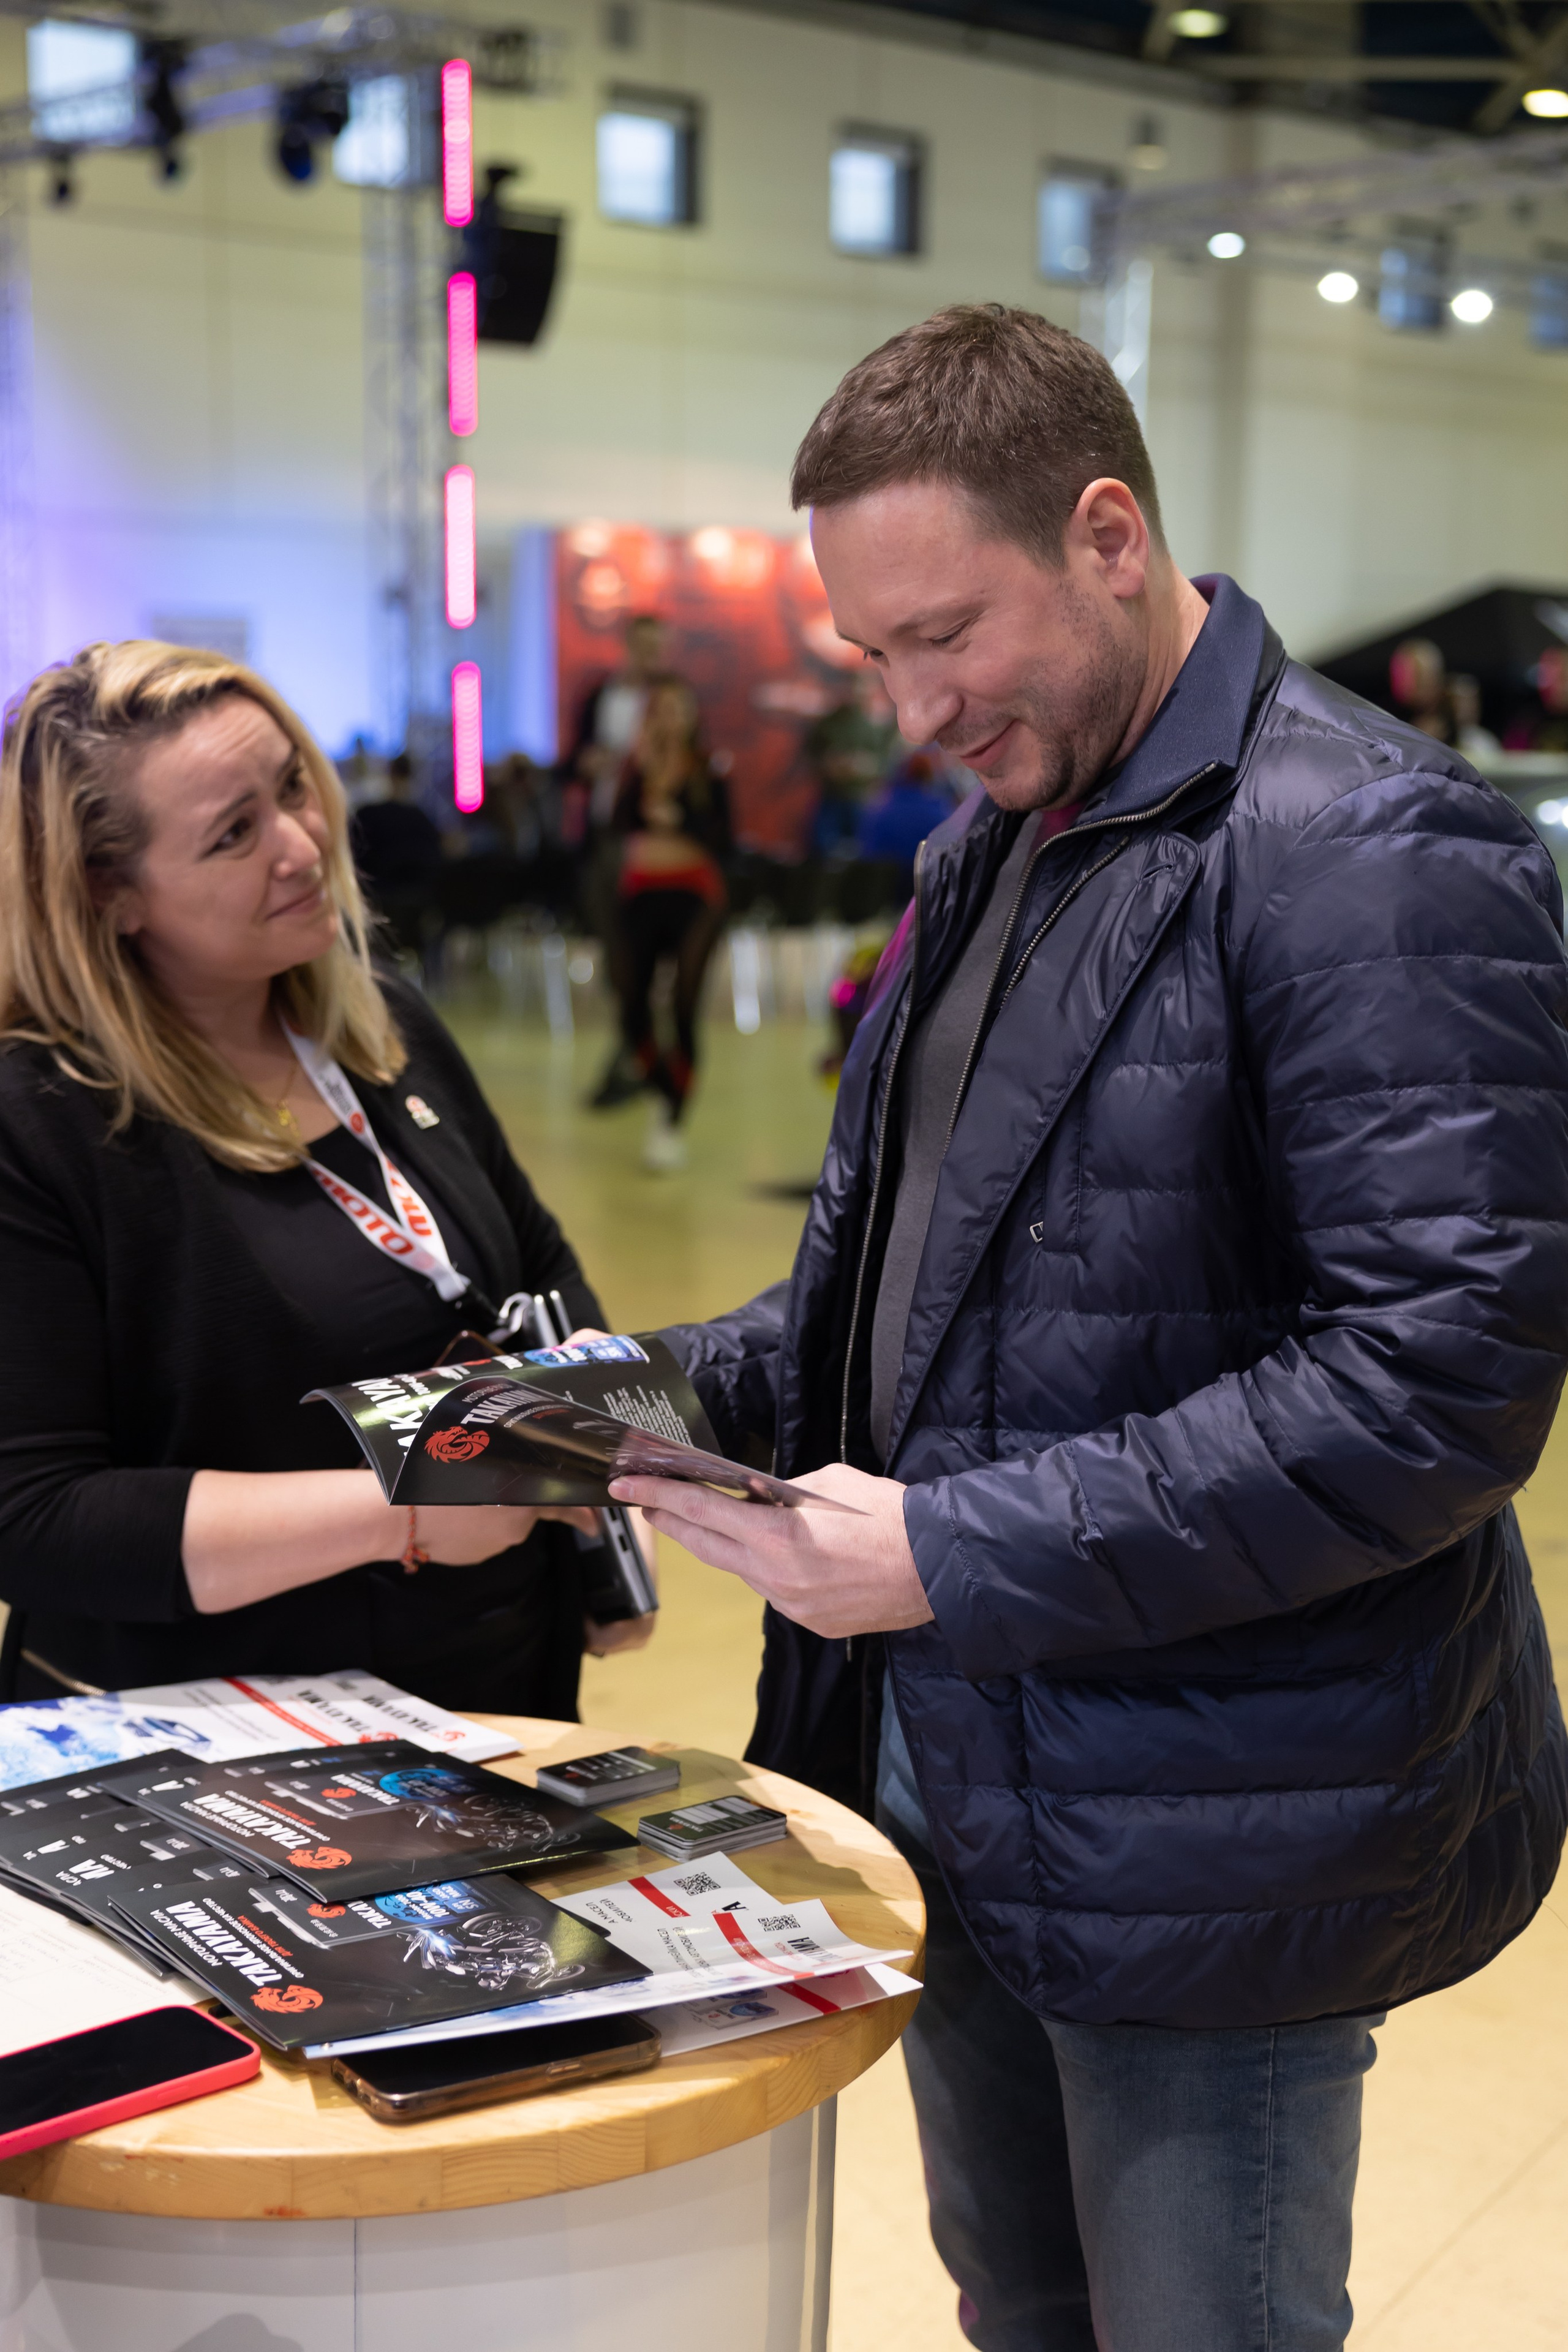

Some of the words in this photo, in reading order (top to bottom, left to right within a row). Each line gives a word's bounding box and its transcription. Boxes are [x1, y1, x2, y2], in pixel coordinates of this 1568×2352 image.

[193, 1793, 311, 1849] TAKAYAMA
[406, 1891, 450, 1918] 10W-40
[459, 1898, 479, 1910] SN
[150, 1909, 182, 1932] МАСЛА
[165, 1901, 282, 1986] TAKAYAMA
[174, 1929, 222, 1967] МОТОРНЫЕ
